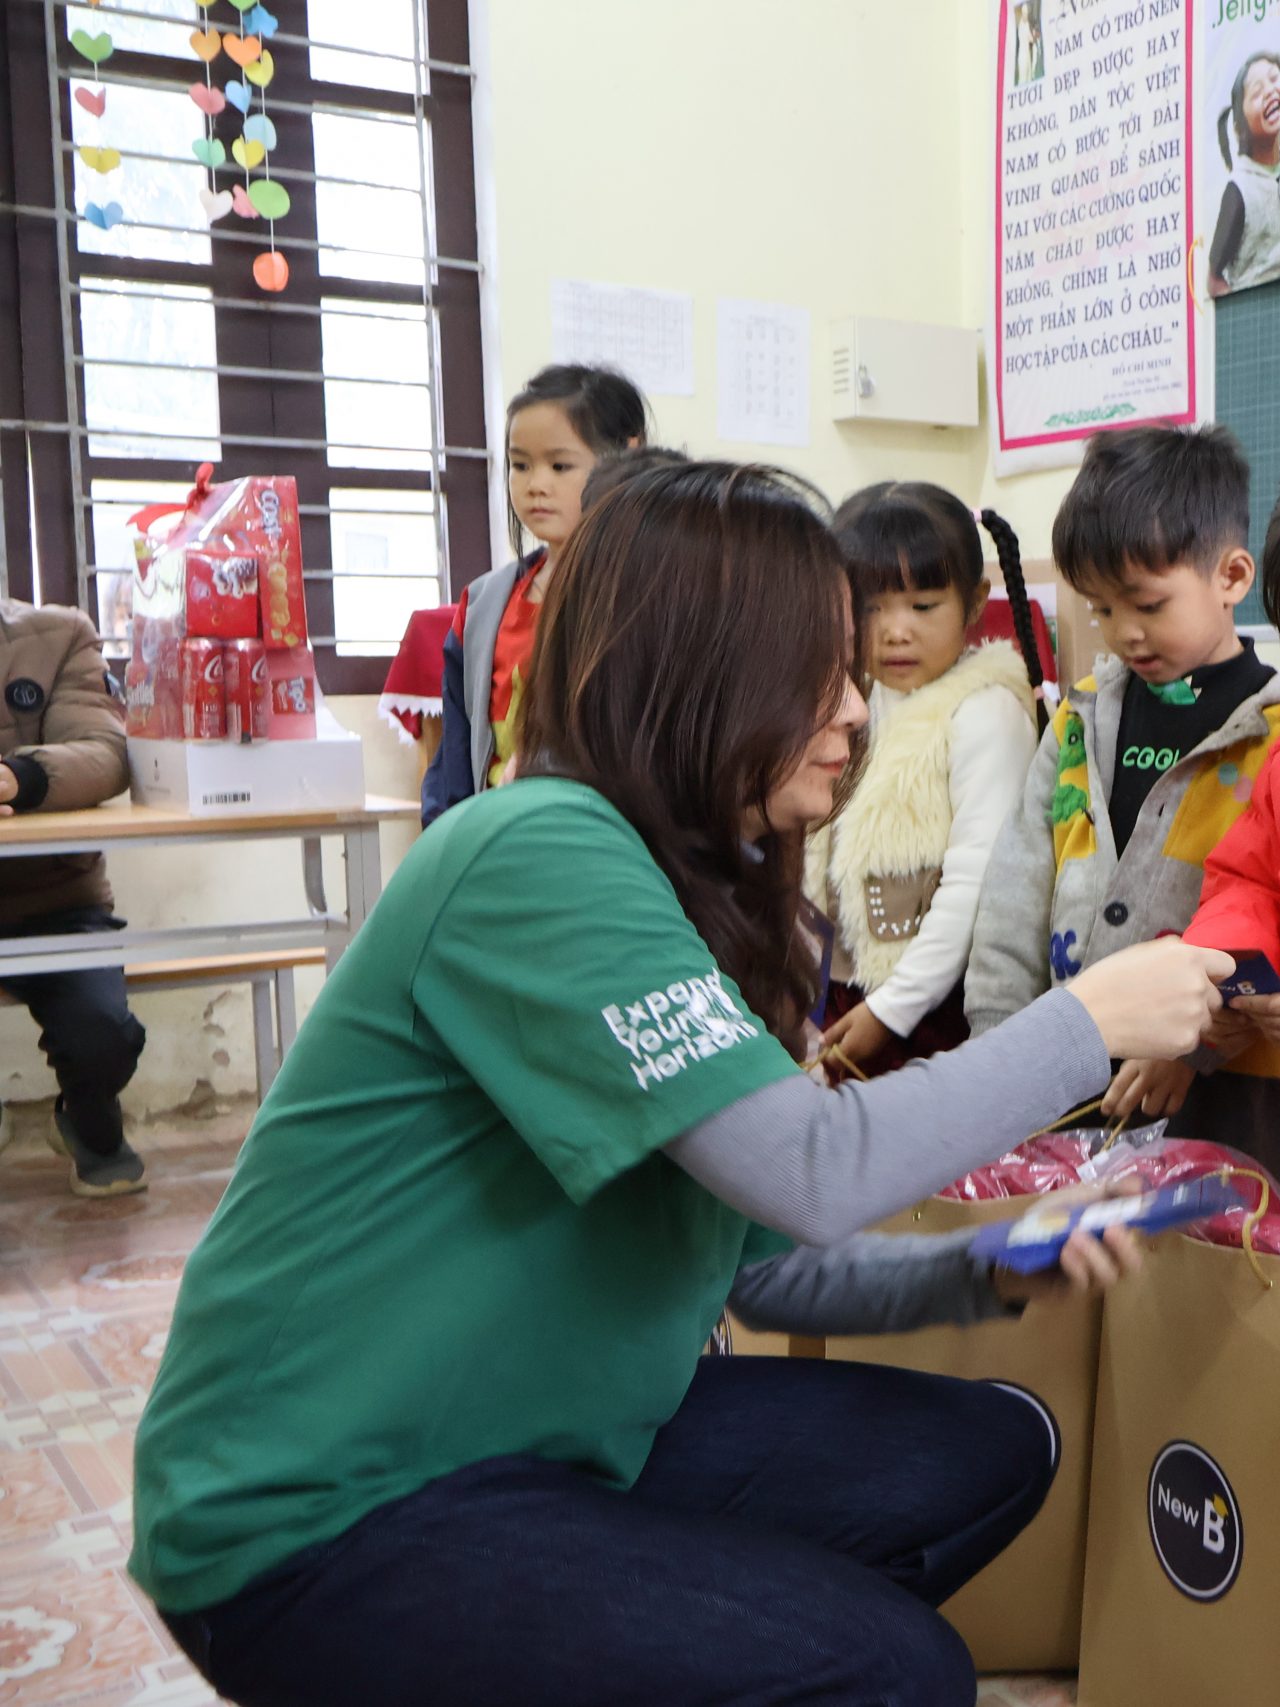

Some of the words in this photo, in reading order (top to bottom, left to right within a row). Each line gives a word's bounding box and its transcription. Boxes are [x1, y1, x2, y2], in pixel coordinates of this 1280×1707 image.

[1053, 30, 1083, 59] NAM
[1146, 29, 1180, 59] HAY
[1005, 151, 1039, 176] NAM
[1005, 183, 1041, 208] VINH
[1051, 166, 1100, 196] QUANG
[1138, 138, 1181, 168] SÁNH
[1005, 220, 1029, 241] VAI
[1060, 203, 1087, 228] CÁC
[1146, 211, 1181, 238] HAY
[1005, 350, 1033, 376] HỌC
[1090, 332, 1119, 358] CÁC
[1158, 1482, 1199, 1528] New
